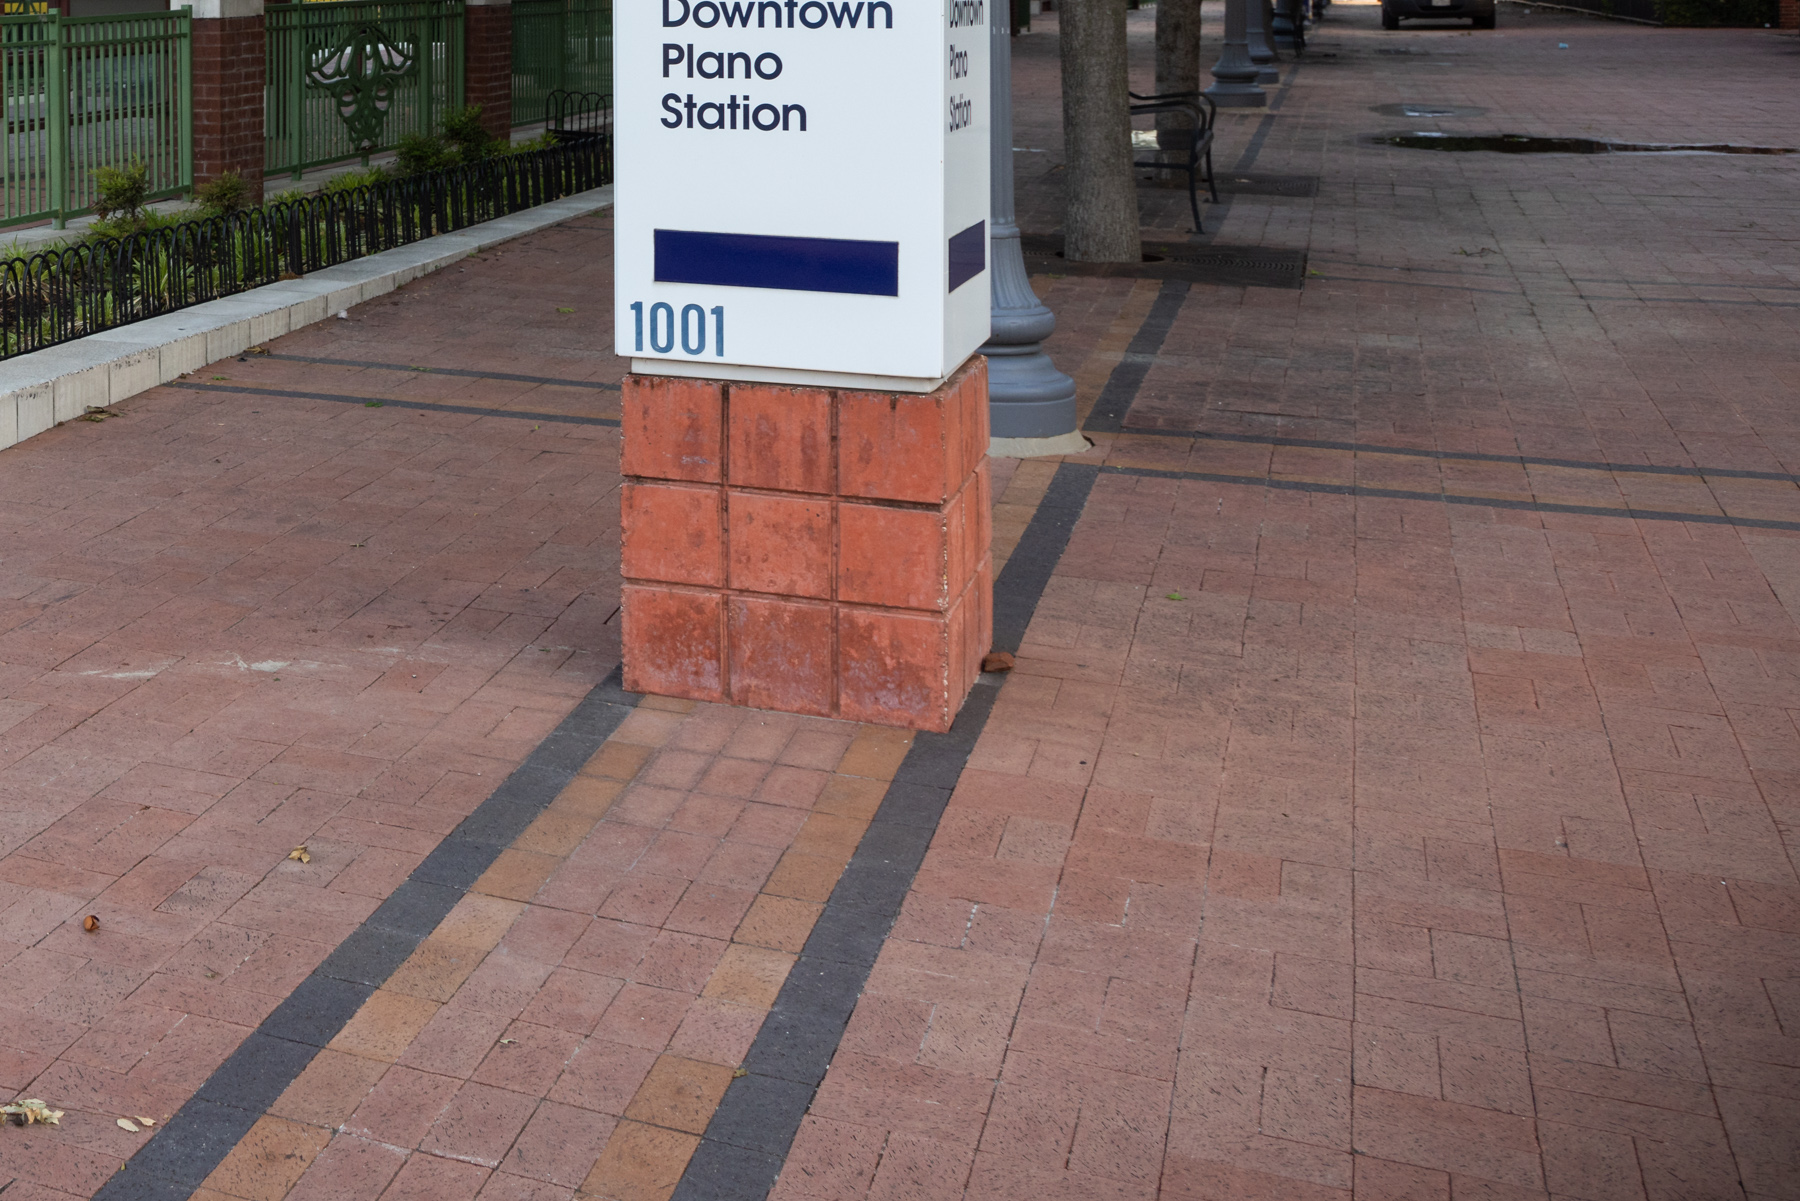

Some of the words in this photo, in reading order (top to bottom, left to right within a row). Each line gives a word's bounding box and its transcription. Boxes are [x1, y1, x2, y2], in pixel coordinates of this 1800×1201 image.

[662, 43, 783, 80] Plano
[949, 44, 968, 80] Plano
[660, 93, 807, 131] Station
[949, 93, 972, 132] Station
[630, 301, 724, 357] 1001
